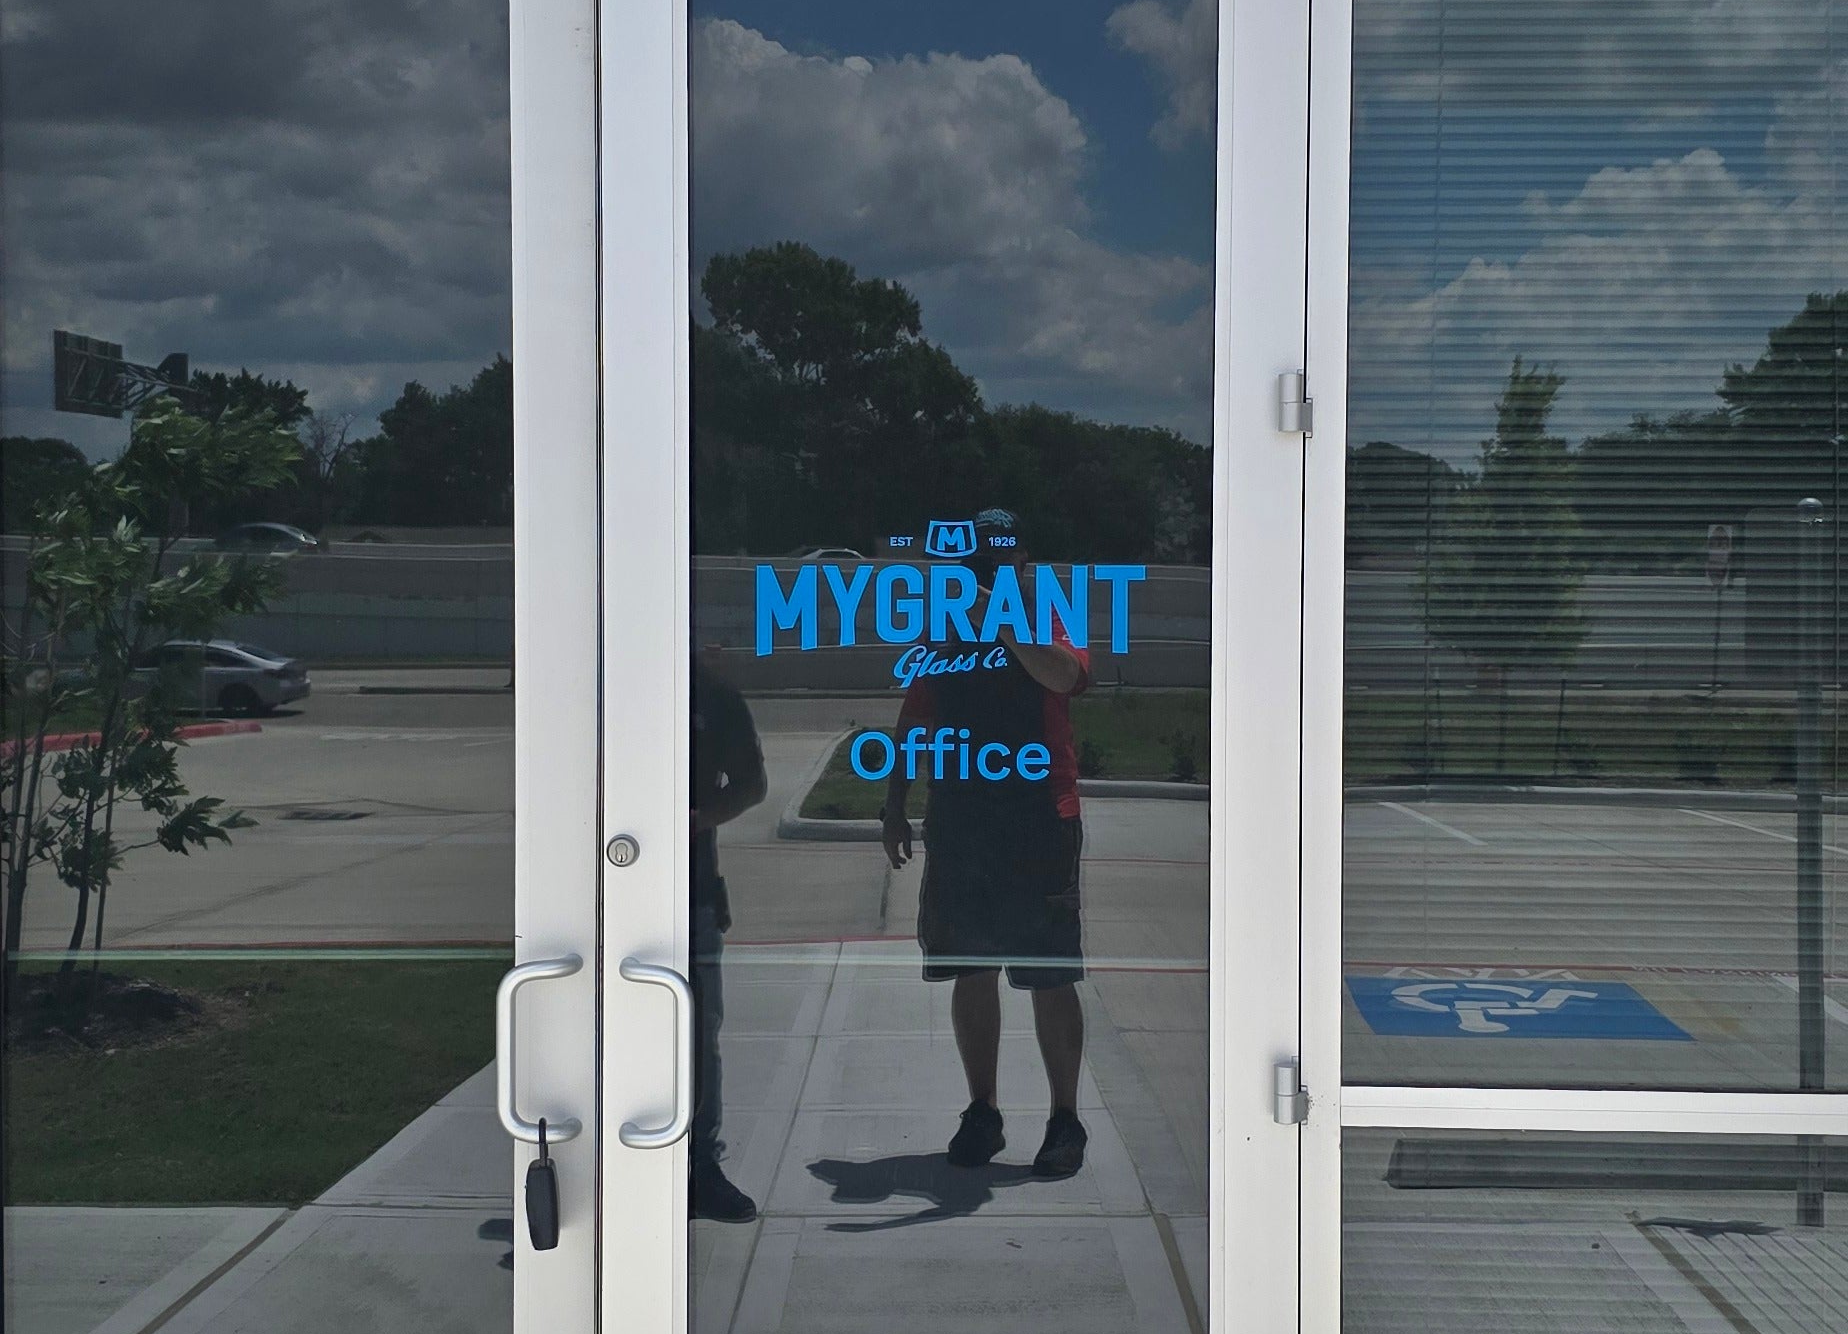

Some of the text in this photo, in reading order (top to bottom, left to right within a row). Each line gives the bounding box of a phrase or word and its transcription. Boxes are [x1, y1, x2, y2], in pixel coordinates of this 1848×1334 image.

[889, 536, 914, 547] EST
[936, 526, 966, 552] M
[988, 536, 1017, 547] 1926
[756, 564, 1147, 656] MYGRANT
[893, 645, 979, 689] Glass
[850, 727, 1051, 781] Office
